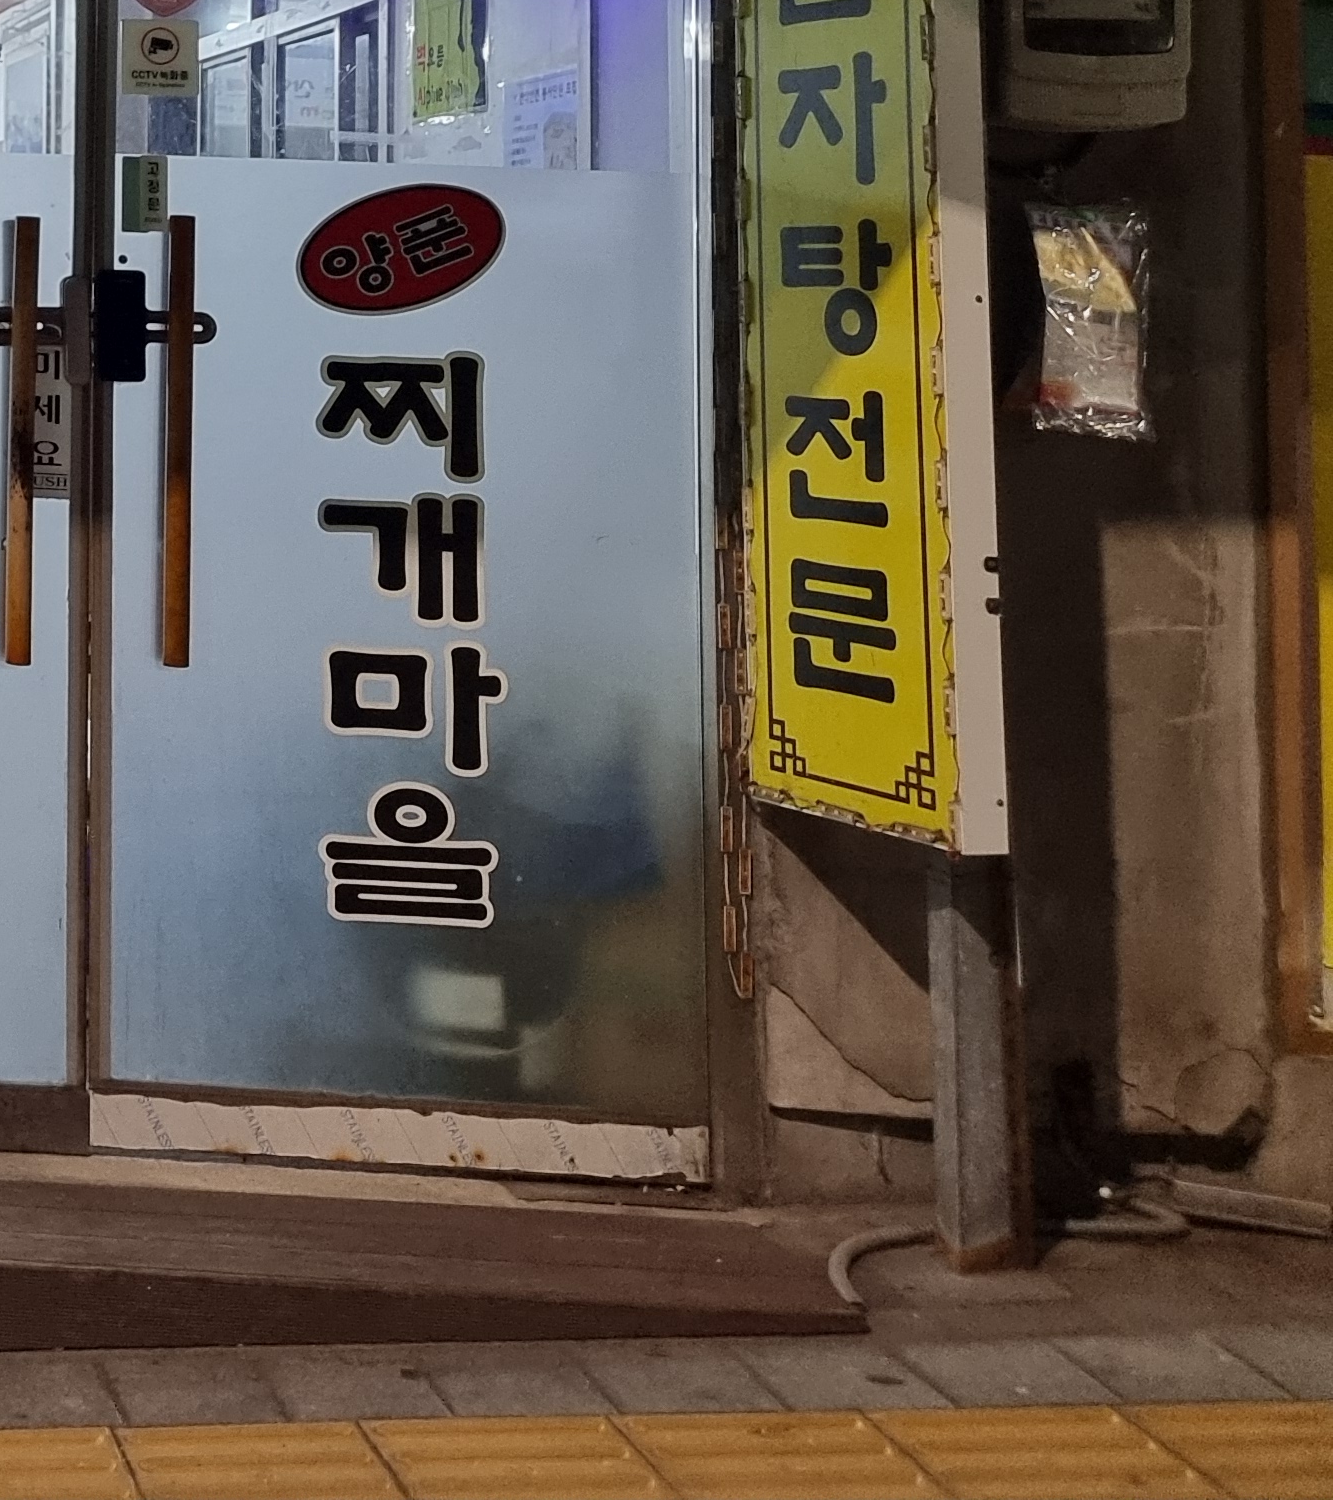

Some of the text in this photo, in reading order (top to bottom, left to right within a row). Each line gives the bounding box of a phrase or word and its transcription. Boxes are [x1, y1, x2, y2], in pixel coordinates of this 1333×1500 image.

[131, 69, 158, 80] CCTV
[320, 203, 475, 296] 양푼
[35, 349, 62, 468] 미세요
[32, 475, 69, 489] USH
[316, 352, 507, 930] 찌개마을
